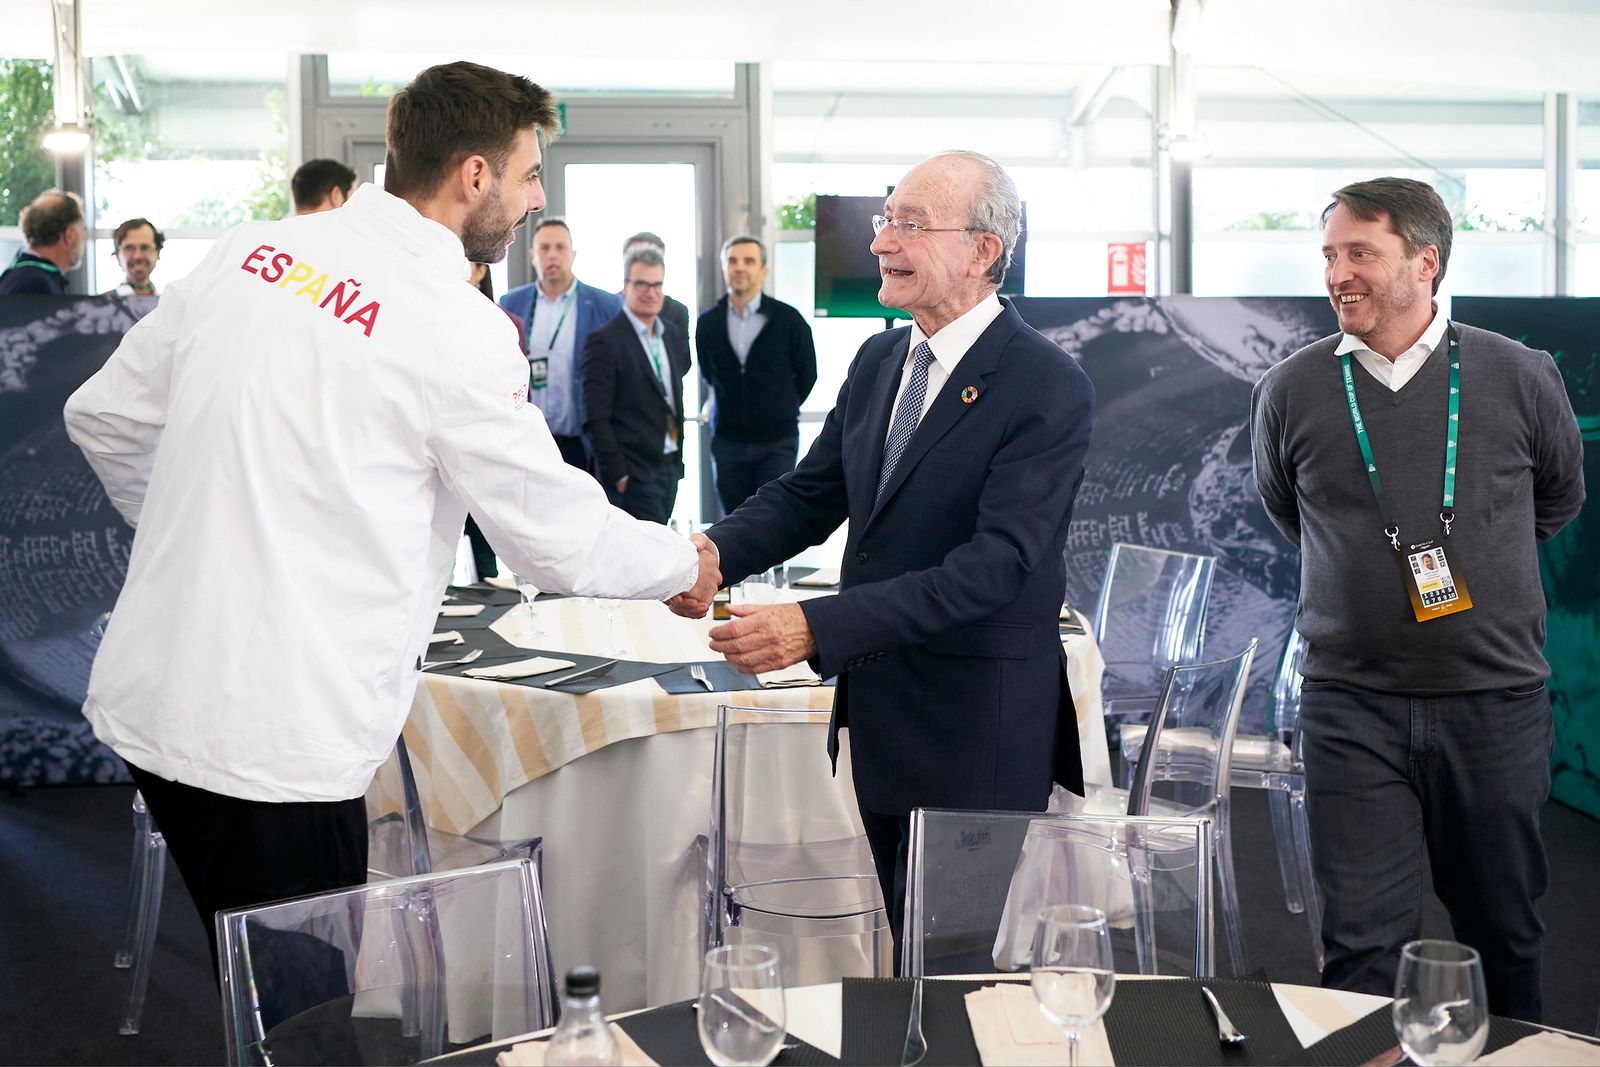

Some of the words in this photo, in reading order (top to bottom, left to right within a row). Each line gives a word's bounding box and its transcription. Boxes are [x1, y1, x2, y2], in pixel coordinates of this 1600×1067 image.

[240, 244, 381, 337] ESPAÑA
[1344, 364, 1352, 383] TENNIS
[1348, 391, 1356, 403] CUP
[1350, 402, 1361, 422] WORLD
[1356, 422, 1364, 434] THE
